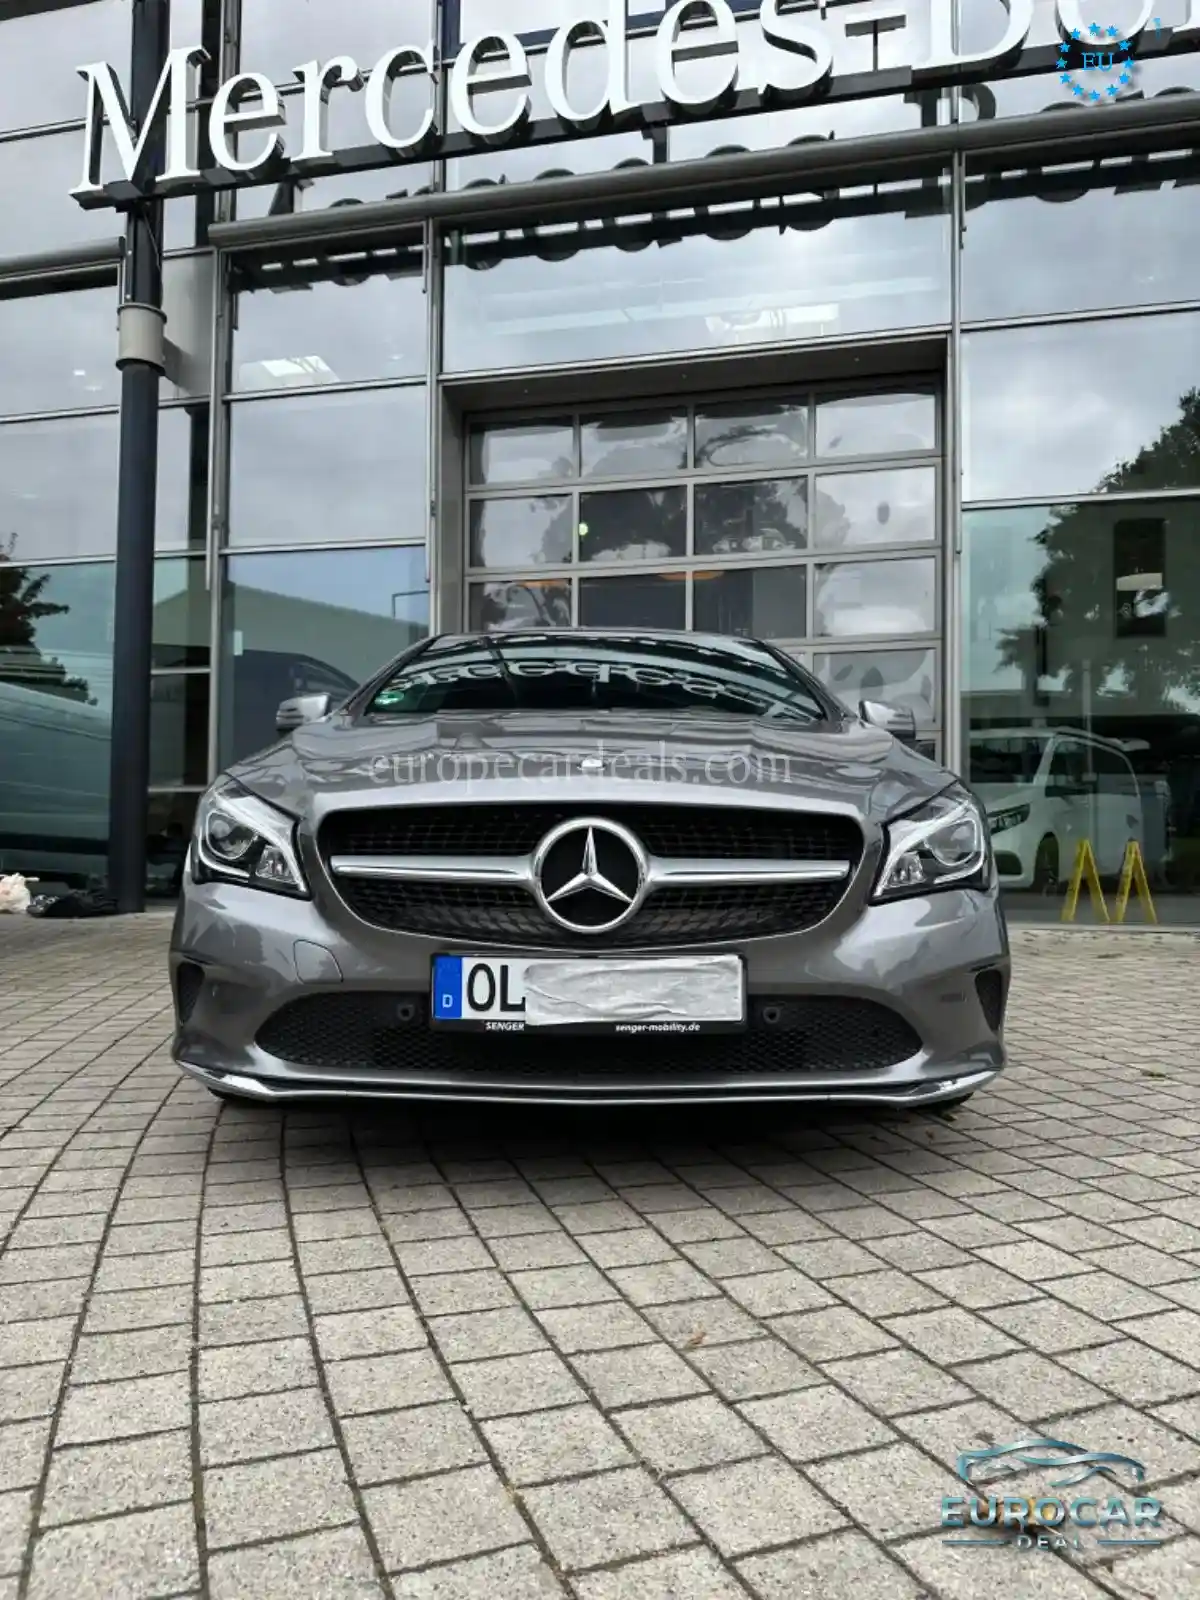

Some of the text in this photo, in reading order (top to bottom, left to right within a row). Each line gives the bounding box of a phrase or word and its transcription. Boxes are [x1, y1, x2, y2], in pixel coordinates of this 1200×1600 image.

[442, 994, 453, 1008] D
[485, 1021, 525, 1031] SENGER
[615, 1022, 701, 1033] senger-mobility.de
